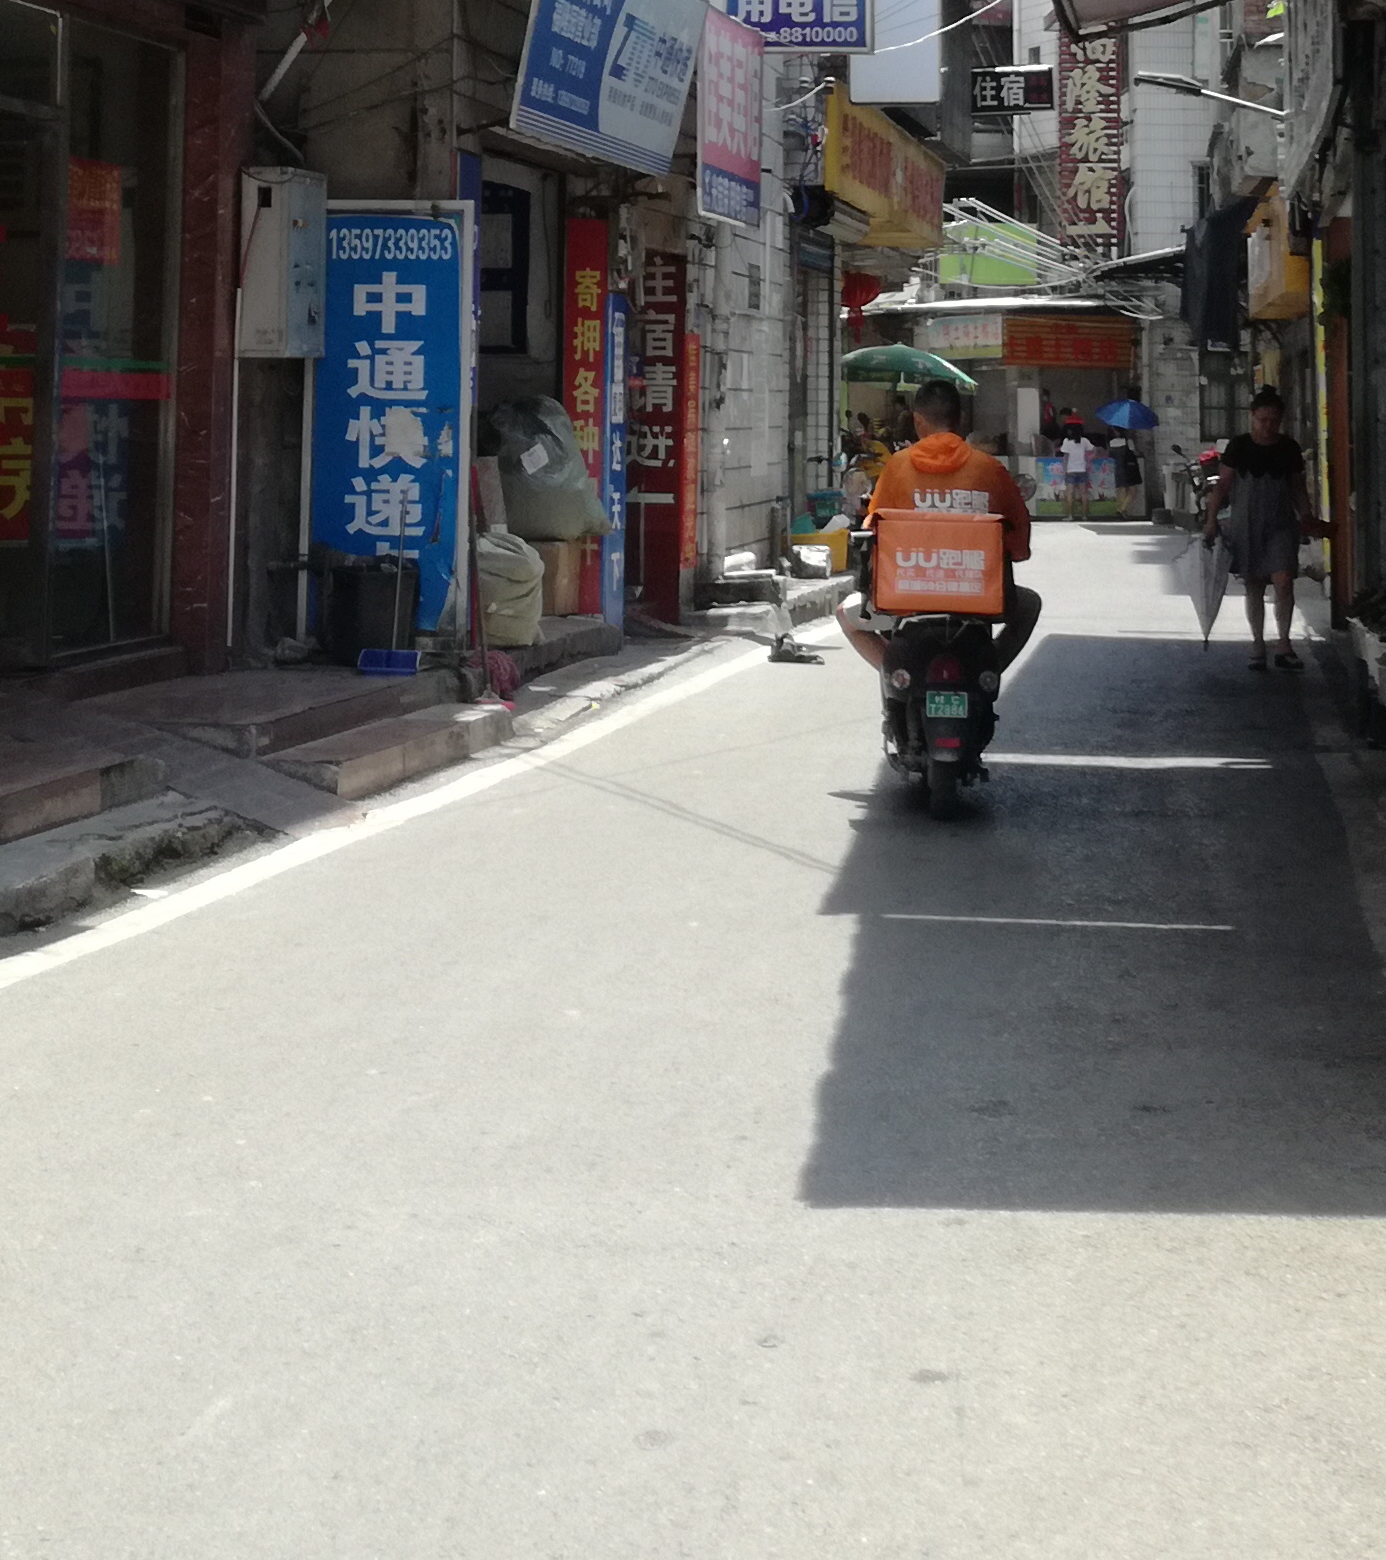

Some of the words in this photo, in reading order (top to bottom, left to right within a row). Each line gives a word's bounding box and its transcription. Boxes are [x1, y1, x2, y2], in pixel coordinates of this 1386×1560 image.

[779, 26, 858, 42] 8810000
[973, 74, 1025, 107] 住宿
[329, 228, 453, 261] 13597339353
[345, 272, 428, 559] 中通快递
